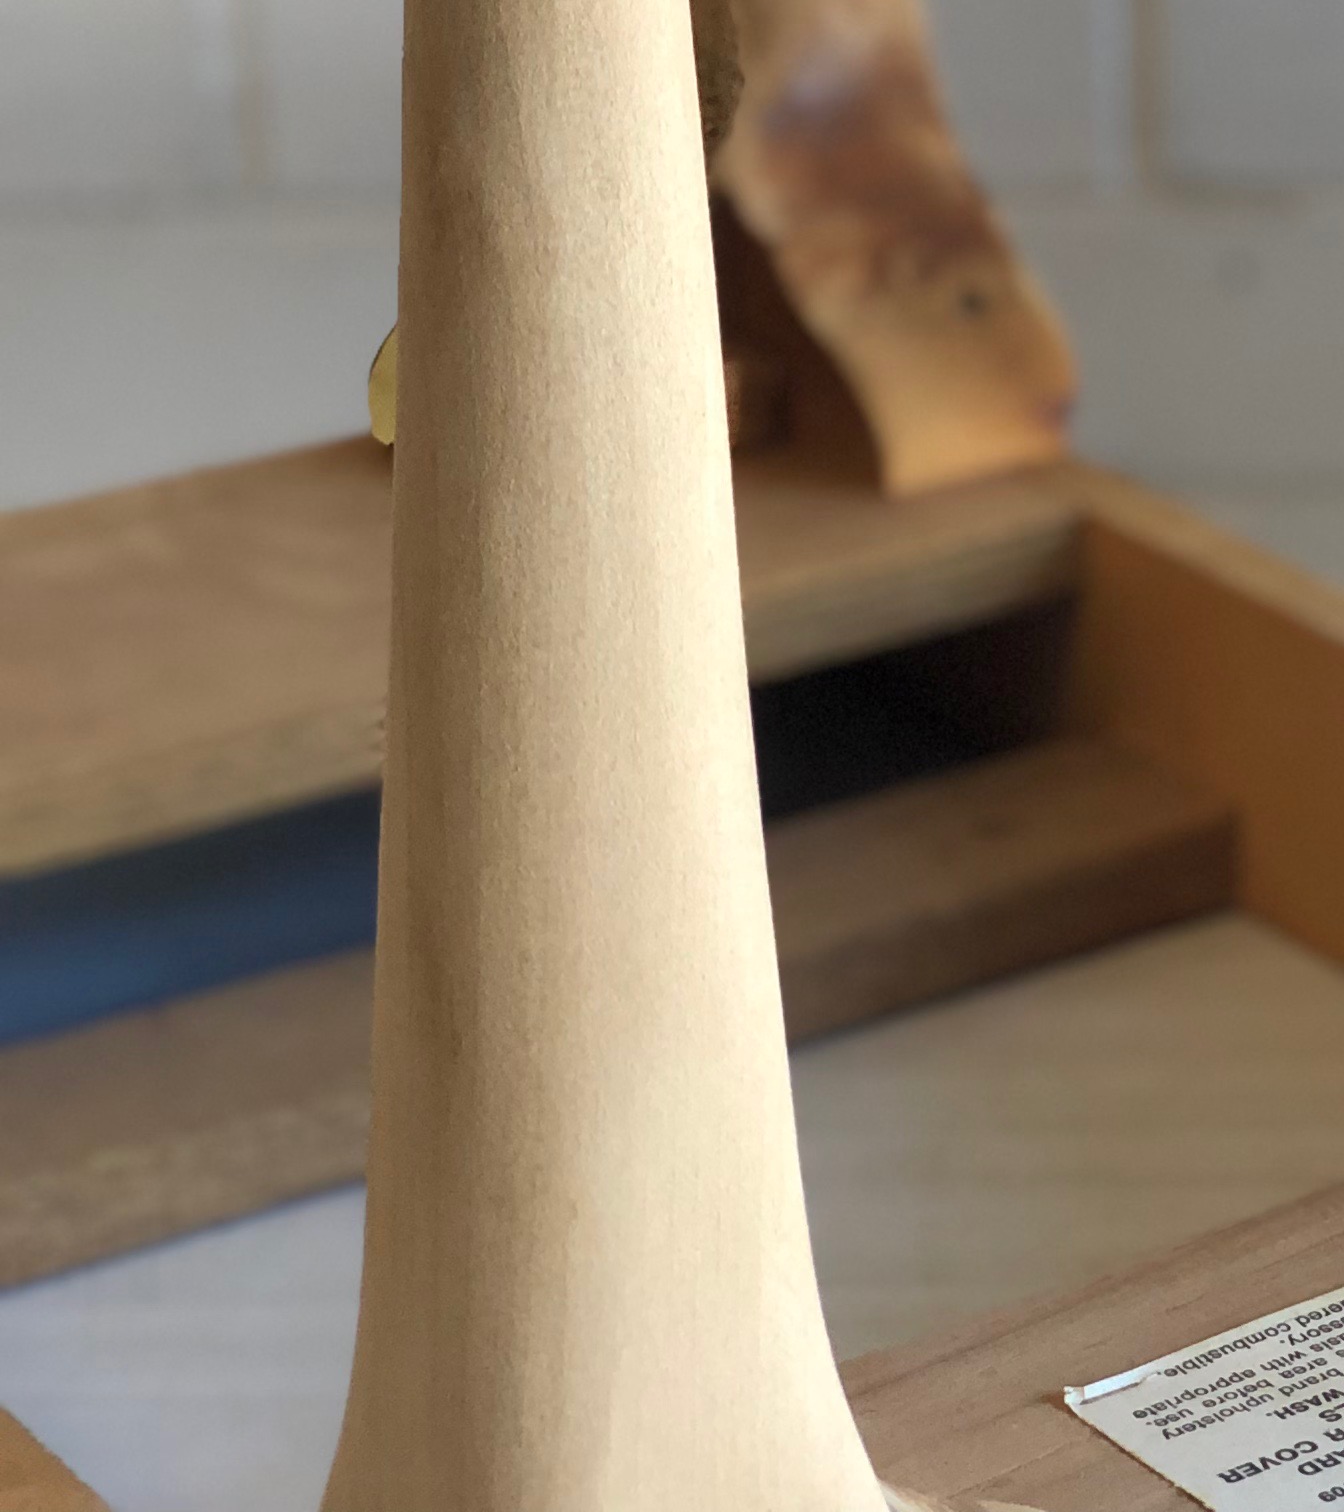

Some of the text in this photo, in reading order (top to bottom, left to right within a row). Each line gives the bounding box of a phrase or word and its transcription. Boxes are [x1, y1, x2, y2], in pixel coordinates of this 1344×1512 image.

[1156, 1321, 1292, 1377] combustible.
[1259, 1350, 1307, 1371] with
[1277, 1357, 1328, 1379] area
[1277, 1367, 1344, 1397] brand
[1131, 1368, 1256, 1419] appropriate
[1201, 1378, 1275, 1408] before
[1145, 1408, 1194, 1427] use.
[1161, 1393, 1274, 1440] upholstery
[1216, 1440, 1319, 1483] COVER
